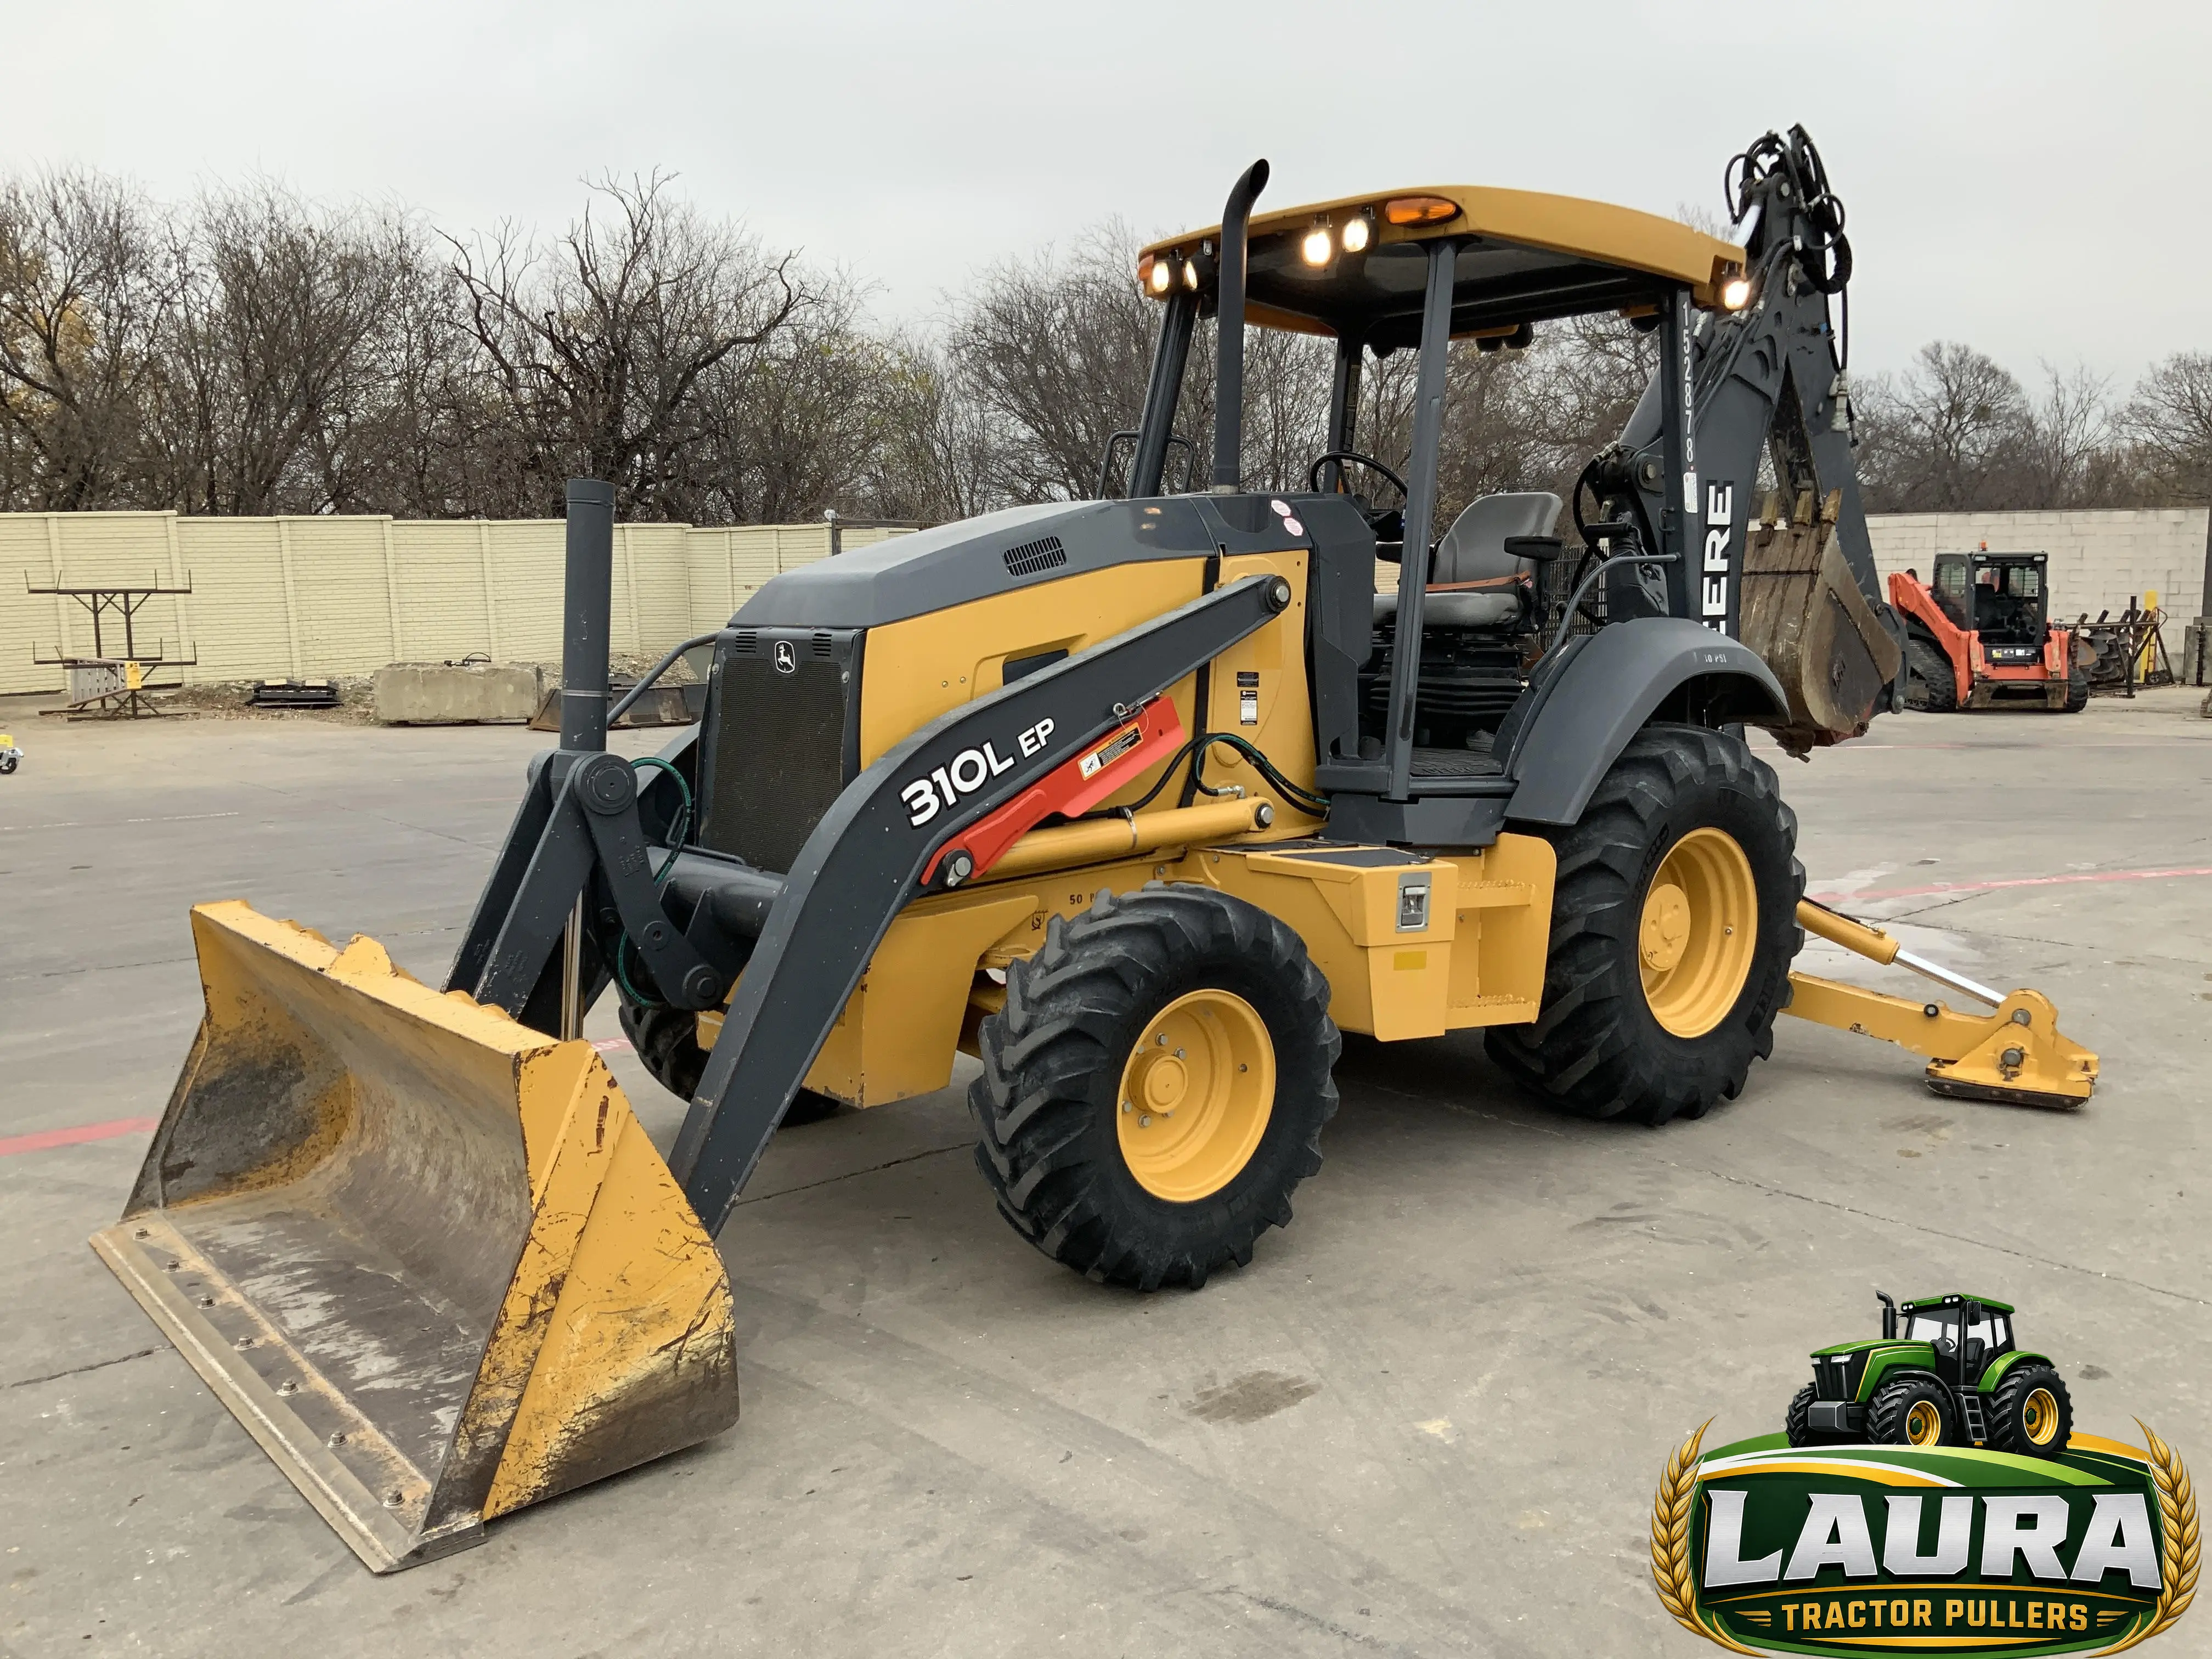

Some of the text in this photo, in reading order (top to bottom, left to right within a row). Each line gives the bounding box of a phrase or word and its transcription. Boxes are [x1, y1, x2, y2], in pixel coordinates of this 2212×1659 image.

[1682, 301, 1694, 462] 152878
[901, 741, 1015, 827] 310L
[1017, 717, 1056, 759] EP
[1070, 894, 1082, 905] 50
